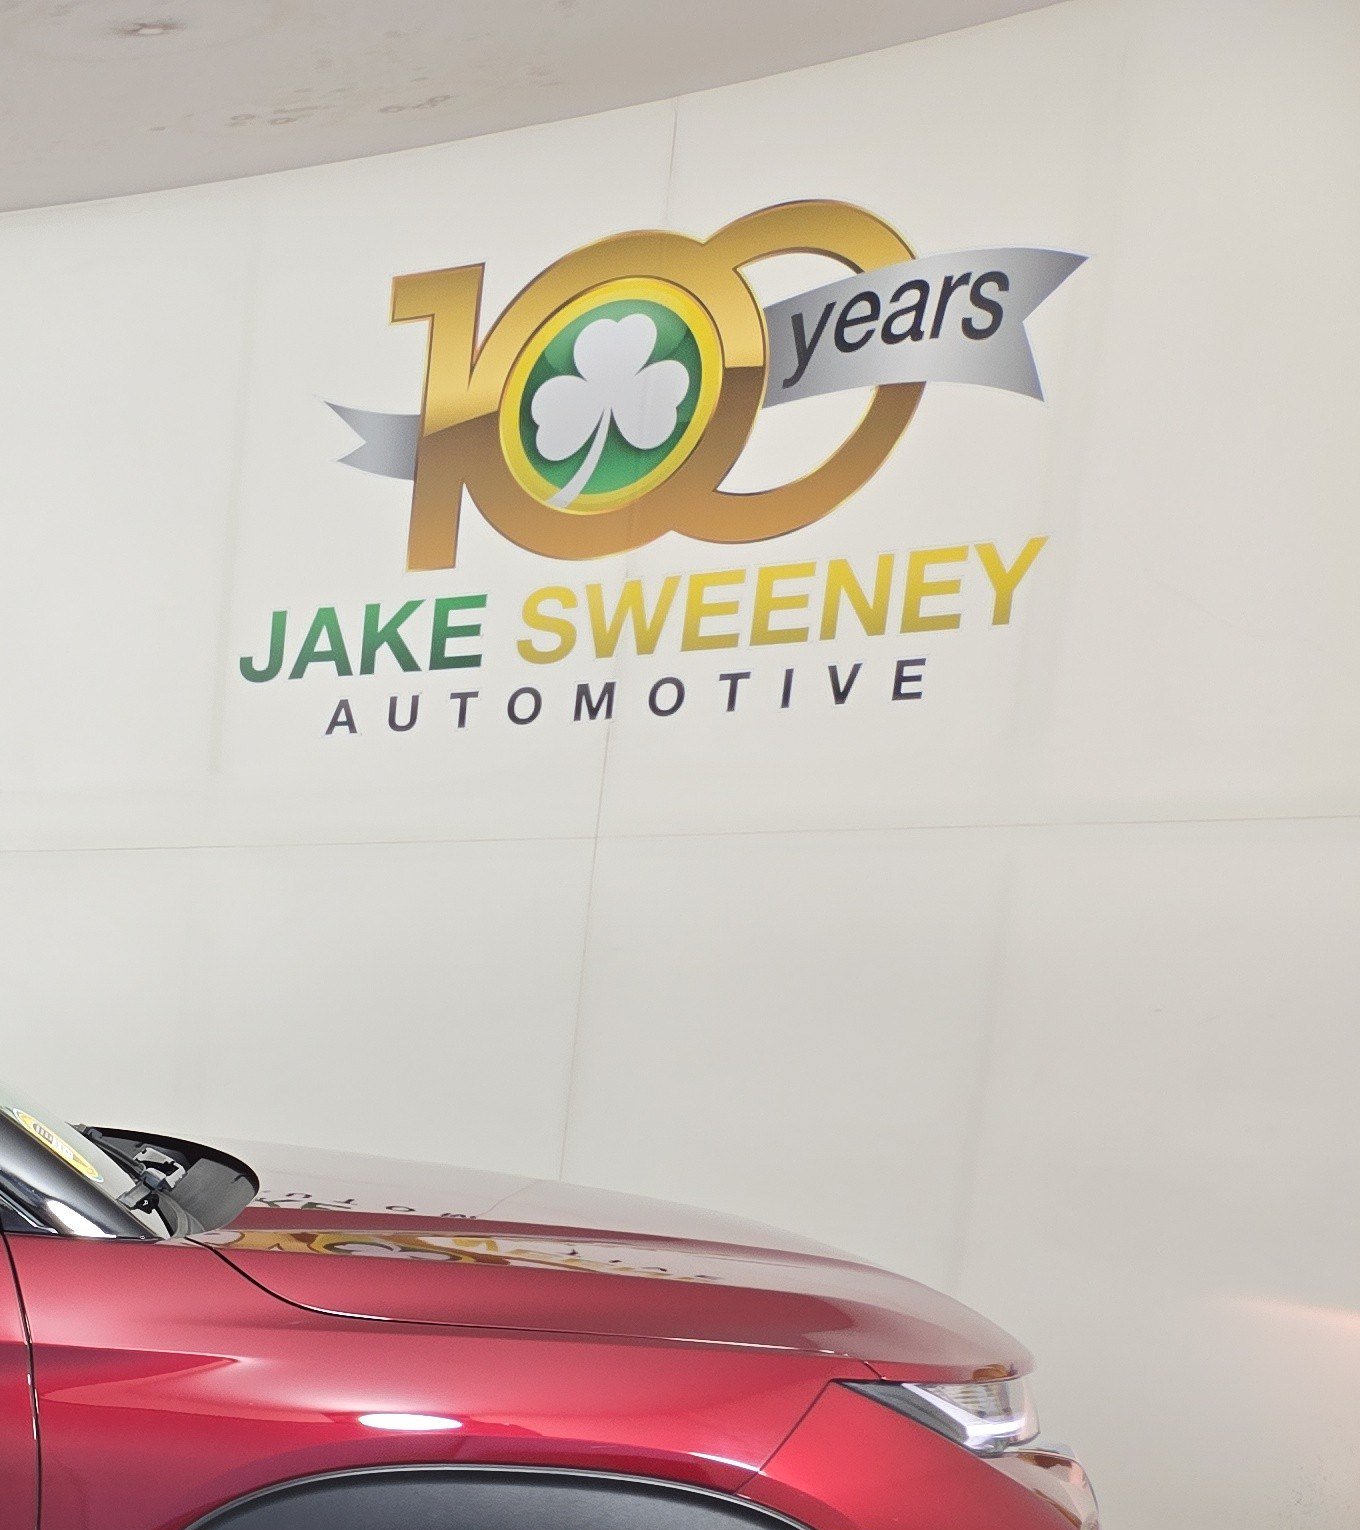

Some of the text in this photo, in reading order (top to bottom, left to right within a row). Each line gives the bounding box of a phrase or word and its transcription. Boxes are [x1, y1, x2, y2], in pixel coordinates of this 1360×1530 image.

[391, 199, 926, 572] 100
[781, 268, 1010, 388] years
[240, 536, 1047, 684] JAKE SWEENEY
[326, 657, 928, 736] AUTOMOTIVE
